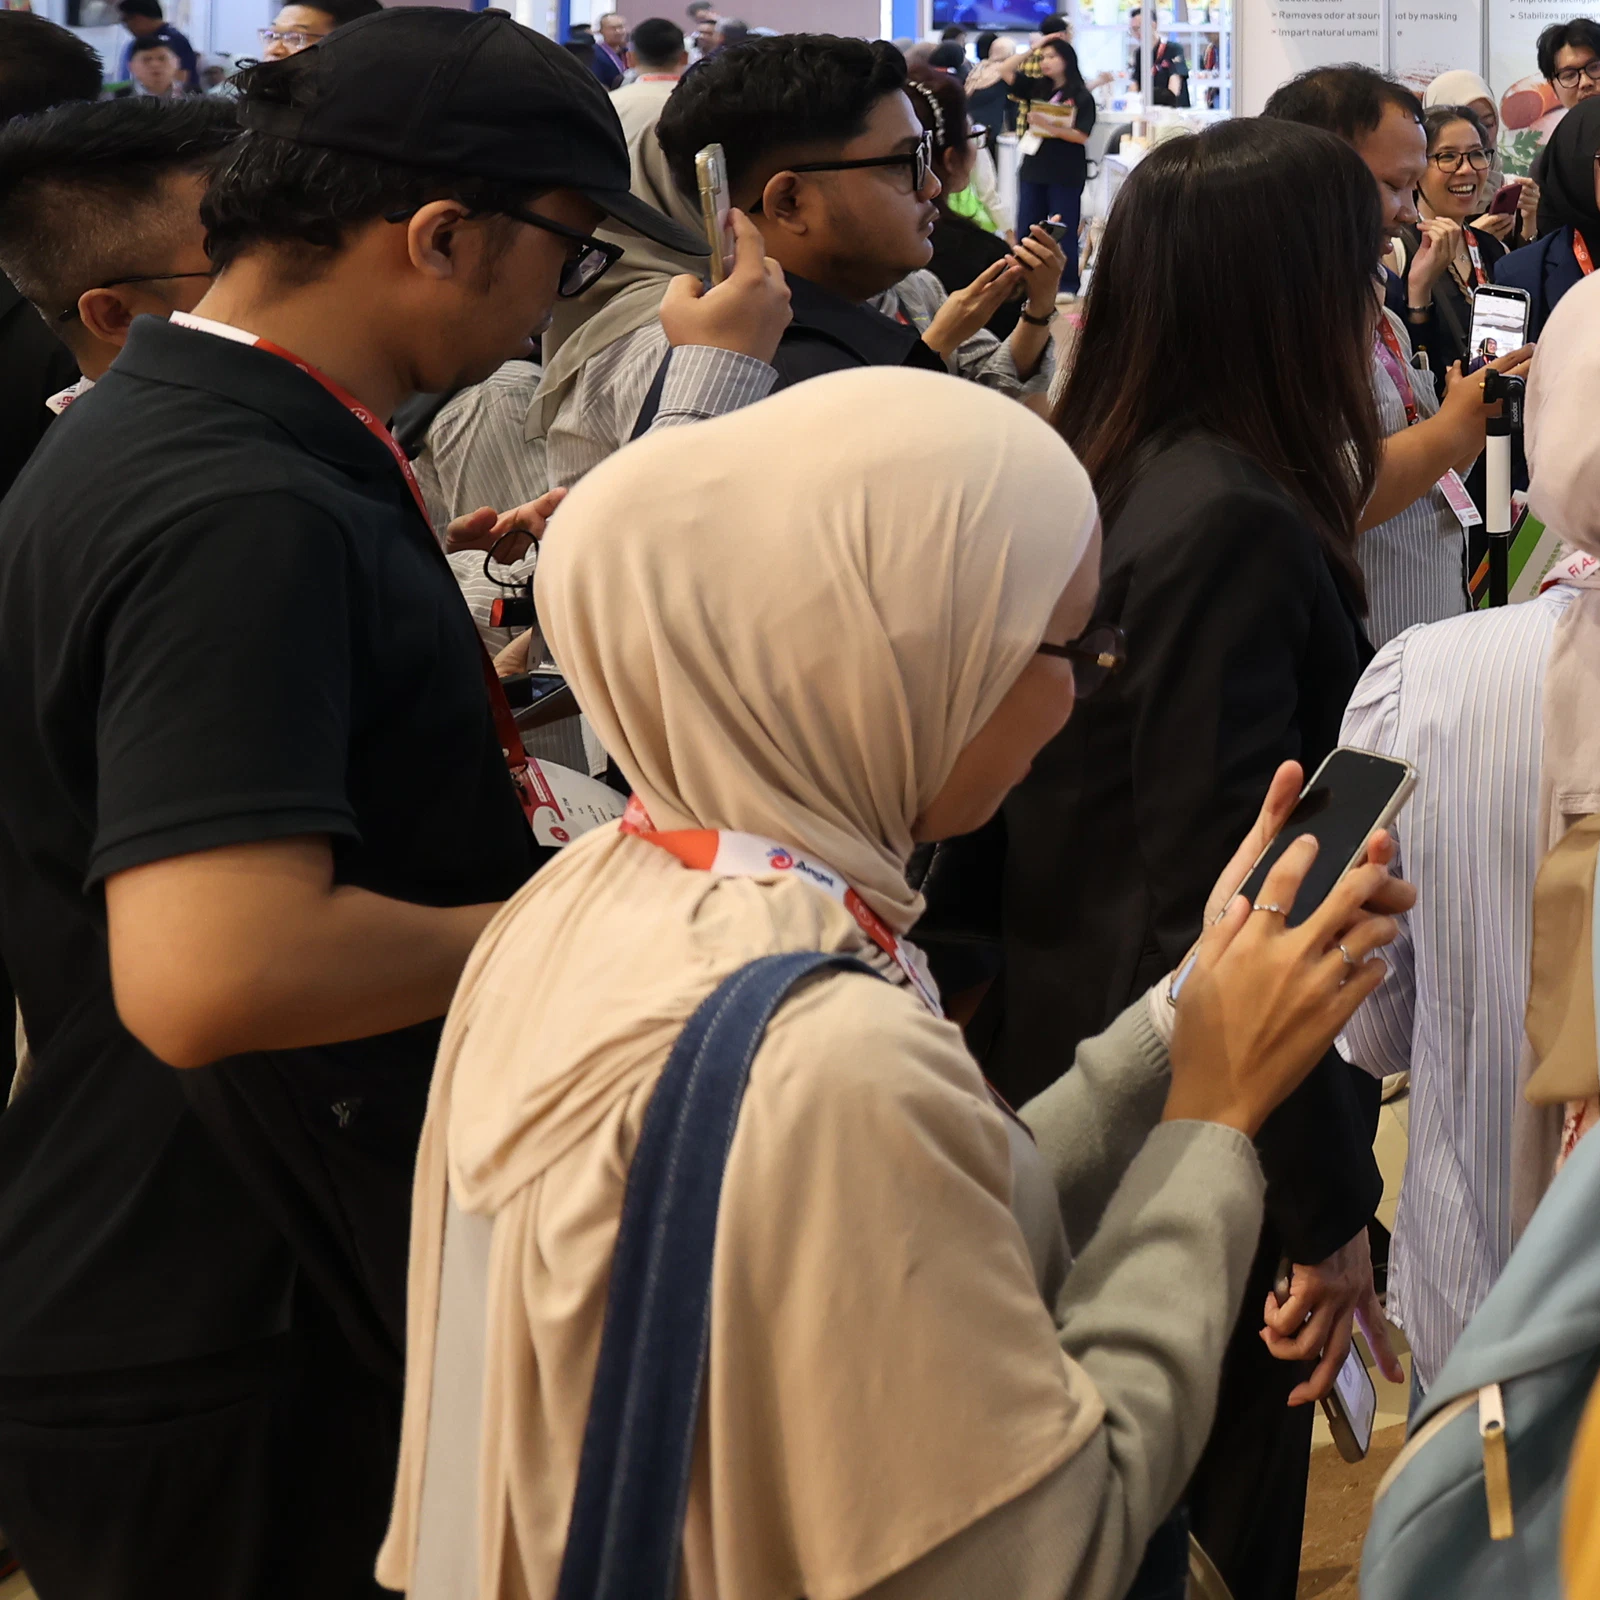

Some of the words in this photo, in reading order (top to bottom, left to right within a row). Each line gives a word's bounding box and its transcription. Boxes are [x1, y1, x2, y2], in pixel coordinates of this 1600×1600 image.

[1279, 10, 1323, 20] Removes
[1324, 11, 1345, 20] odor
[1347, 12, 1355, 20] at
[1408, 12, 1418, 23] by
[1420, 11, 1458, 23] masking
[1518, 11, 1559, 20] Stabilizes
[1279, 28, 1310, 38] Impart
[1312, 28, 1345, 37] natural
[1347, 28, 1379, 37] umami
[1568, 563, 1581, 578] Fi
